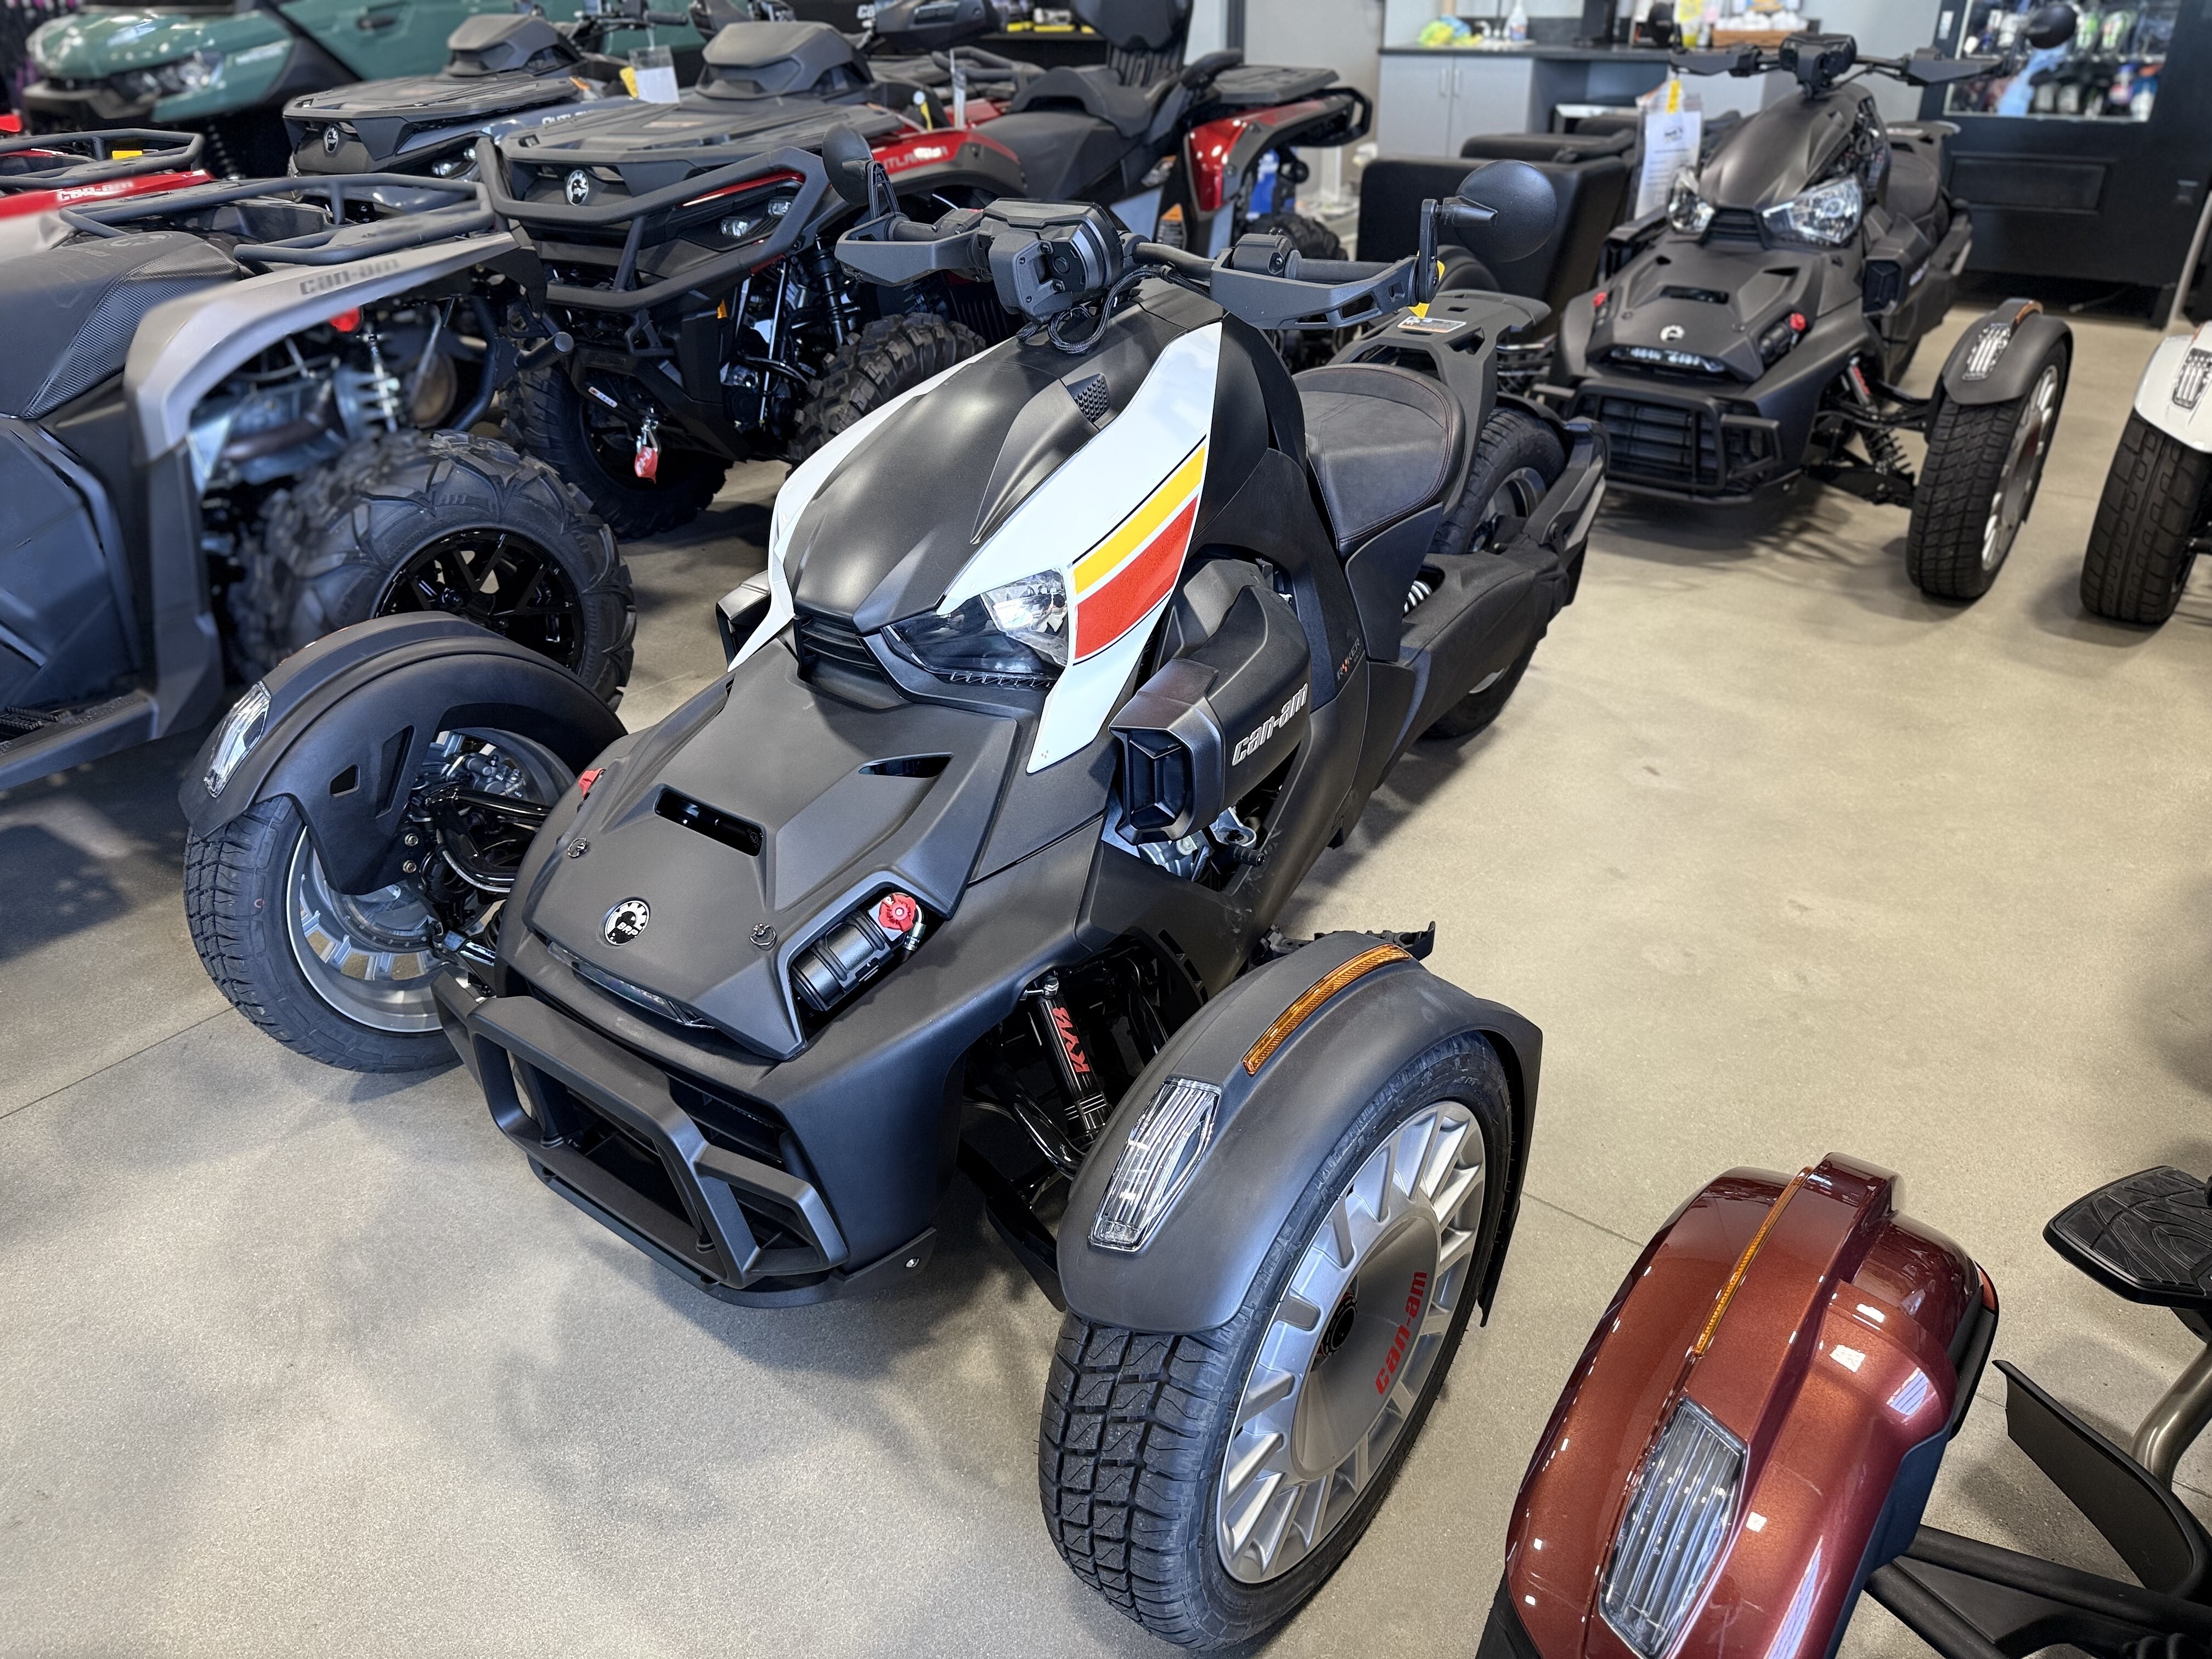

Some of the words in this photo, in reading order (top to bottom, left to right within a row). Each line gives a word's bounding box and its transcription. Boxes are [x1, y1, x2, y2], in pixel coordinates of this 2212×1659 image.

[1337, 637, 1360, 680] RYKER
[1232, 682, 1308, 766] can-am
[617, 922, 639, 935] BRP
[1052, 1007, 1090, 1073] KYB
[1375, 1271, 1427, 1396] can-am
